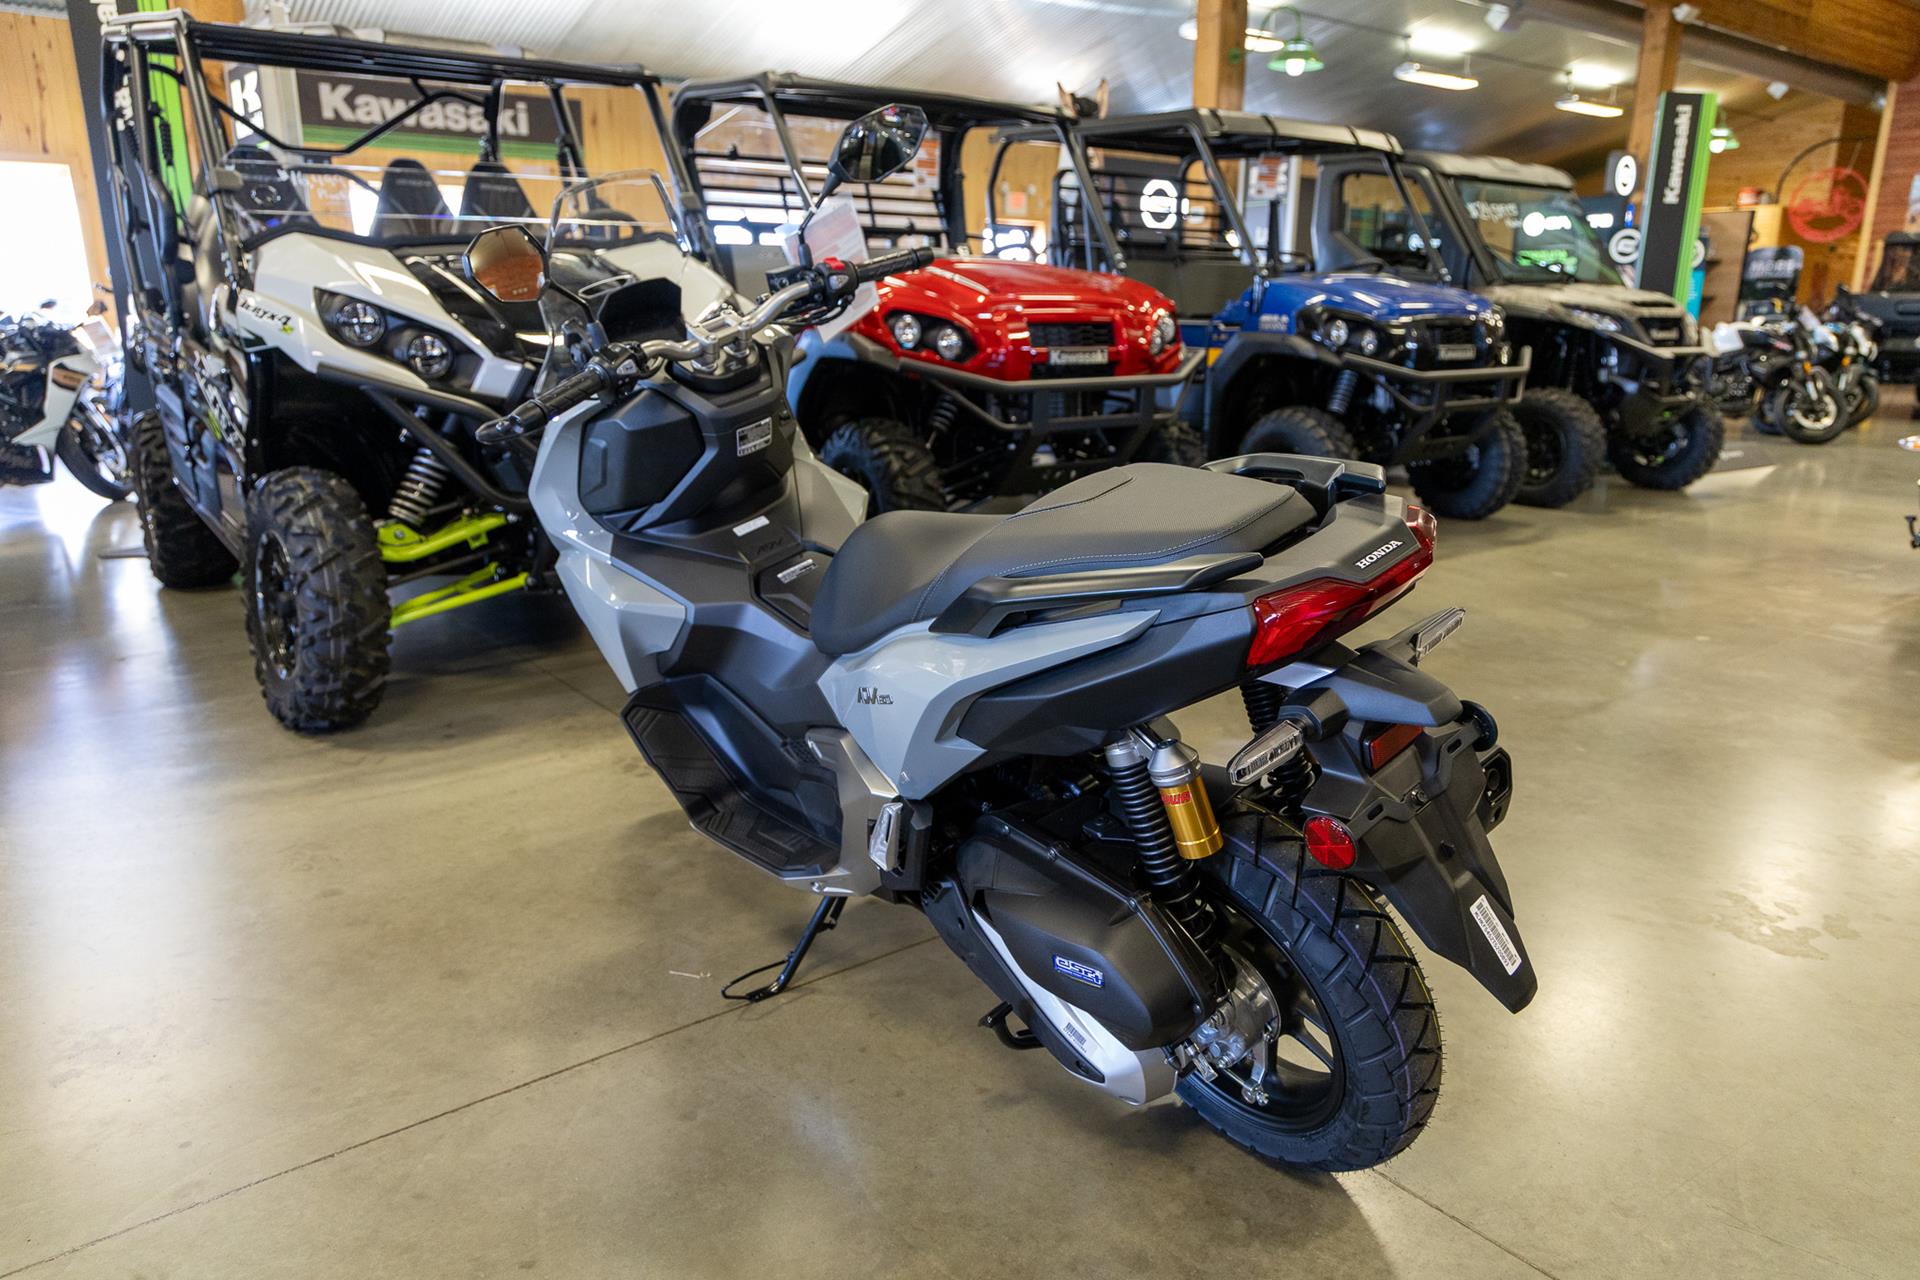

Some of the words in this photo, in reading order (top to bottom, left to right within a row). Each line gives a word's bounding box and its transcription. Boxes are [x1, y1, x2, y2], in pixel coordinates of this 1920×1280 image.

[318, 82, 530, 136] Kawasaki
[1662, 104, 1693, 204] Kawasaki
[1355, 540, 1403, 569] HONDA
